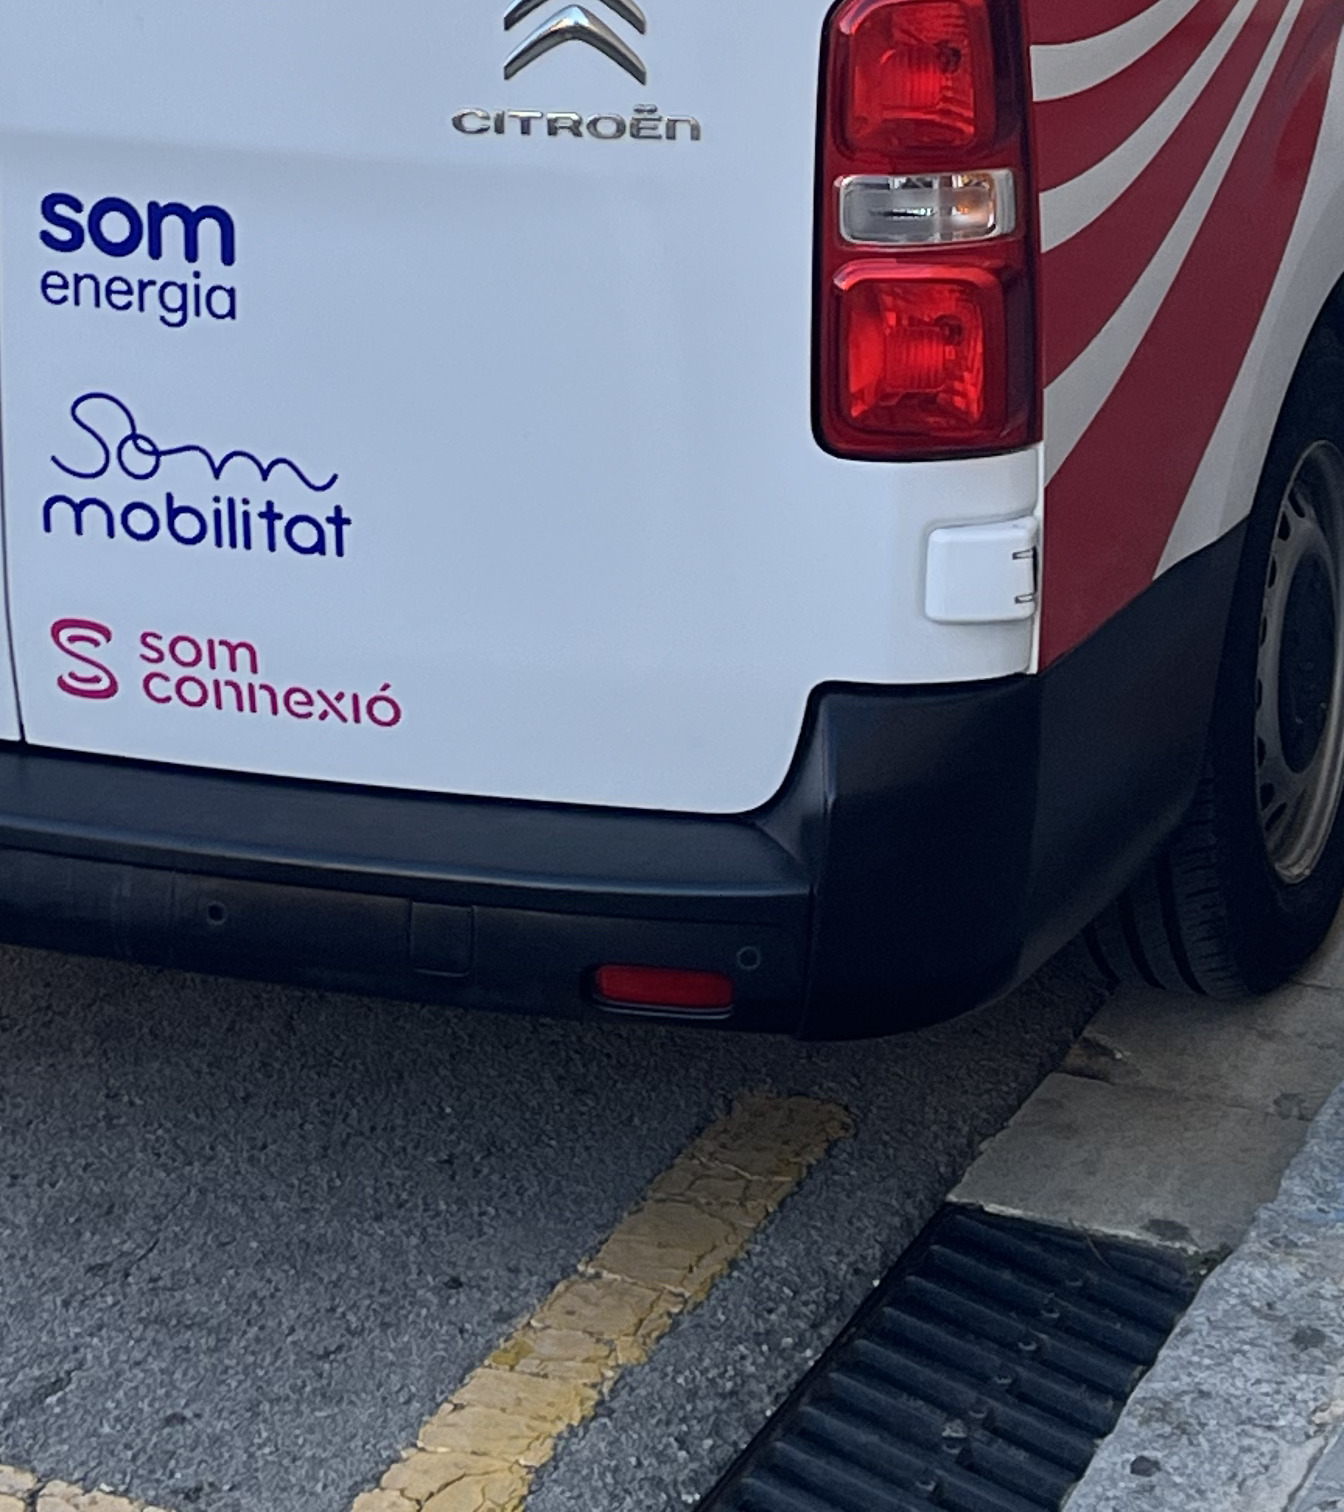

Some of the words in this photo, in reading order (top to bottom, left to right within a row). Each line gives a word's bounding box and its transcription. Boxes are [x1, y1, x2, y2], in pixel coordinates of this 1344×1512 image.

[38, 192, 237, 266] som
[40, 269, 237, 328] energia
[50, 392, 338, 492] Som
[42, 491, 352, 558] mobilitat
[138, 630, 258, 674] som
[142, 672, 402, 728] connexió
